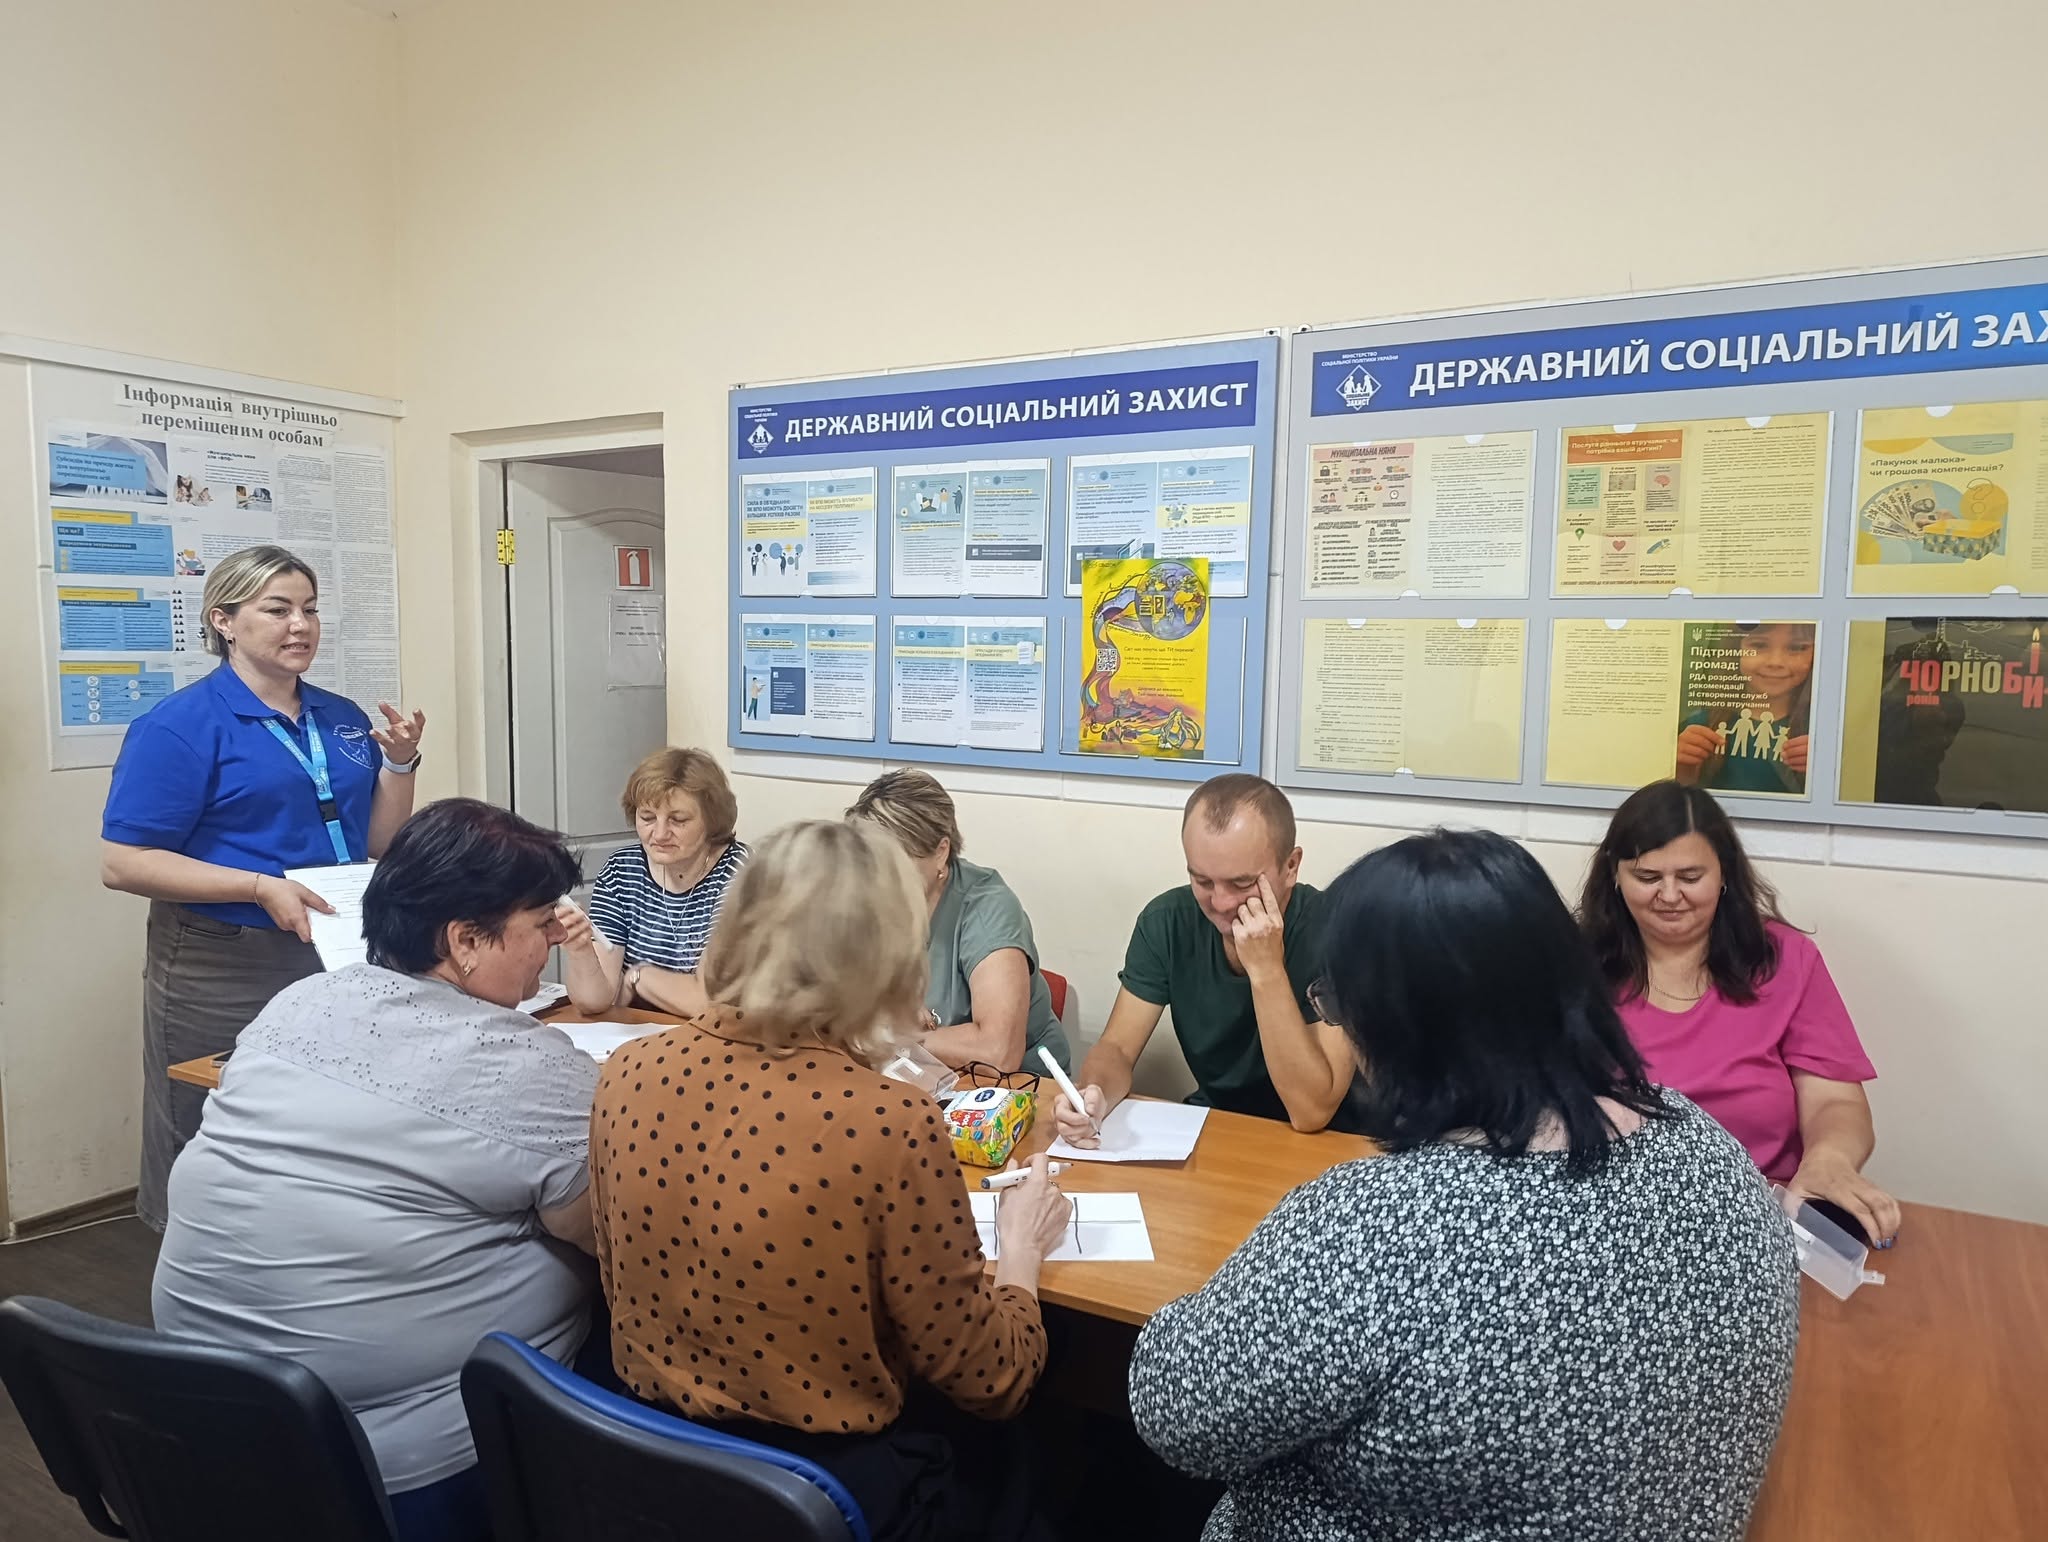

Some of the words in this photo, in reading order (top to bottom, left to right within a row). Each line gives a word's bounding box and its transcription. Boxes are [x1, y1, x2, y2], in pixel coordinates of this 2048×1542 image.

[1342, 351, 1378, 359] МІНІСТЕРСТВО
[1408, 338, 1650, 398] ДЕРЖАВНИЙ
[1660, 312, 1959, 374] СОЦІАЛЬНИЙ
[1321, 359, 1351, 367] СОЦІАЛЬНОЇ
[123, 384, 232, 412] Інформація
[241, 401, 337, 427] внутрішньо
[785, 405, 934, 443] ДЕРЖАВНИЙ
[941, 390, 1120, 429] СОЦІАЛЬНИЙ
[1128, 382, 1249, 413] ЗАХИСТ
[142, 412, 263, 440] переміщеним
[268, 430, 323, 447] особам
[1586, 448, 1615, 456] потрібна
[1636, 445, 1663, 453] дитині?
[1600, 441, 1631, 449] раннього
[1330, 448, 1377, 459] МУНІЦИПАЛЬНА
[1378, 446, 1397, 455] НЯНЯ
[1870, 458, 1918, 468] «Пакунок
[1921, 456, 1966, 465] малюка»
[1884, 468, 1928, 478] грошова
[1931, 463, 2005, 475] компенсація?
[1690, 646, 1758, 659] Підтримка
[1689, 660, 1739, 671] громад:
[1689, 672, 1707, 681] РДА
[1707, 674, 1752, 683] розробляє
[1688, 683, 1744, 691] рекомендації
[1740, 692, 1768, 701] служб
[1687, 700, 1726, 708] раннього
[1726, 701, 1770, 709] втручання
